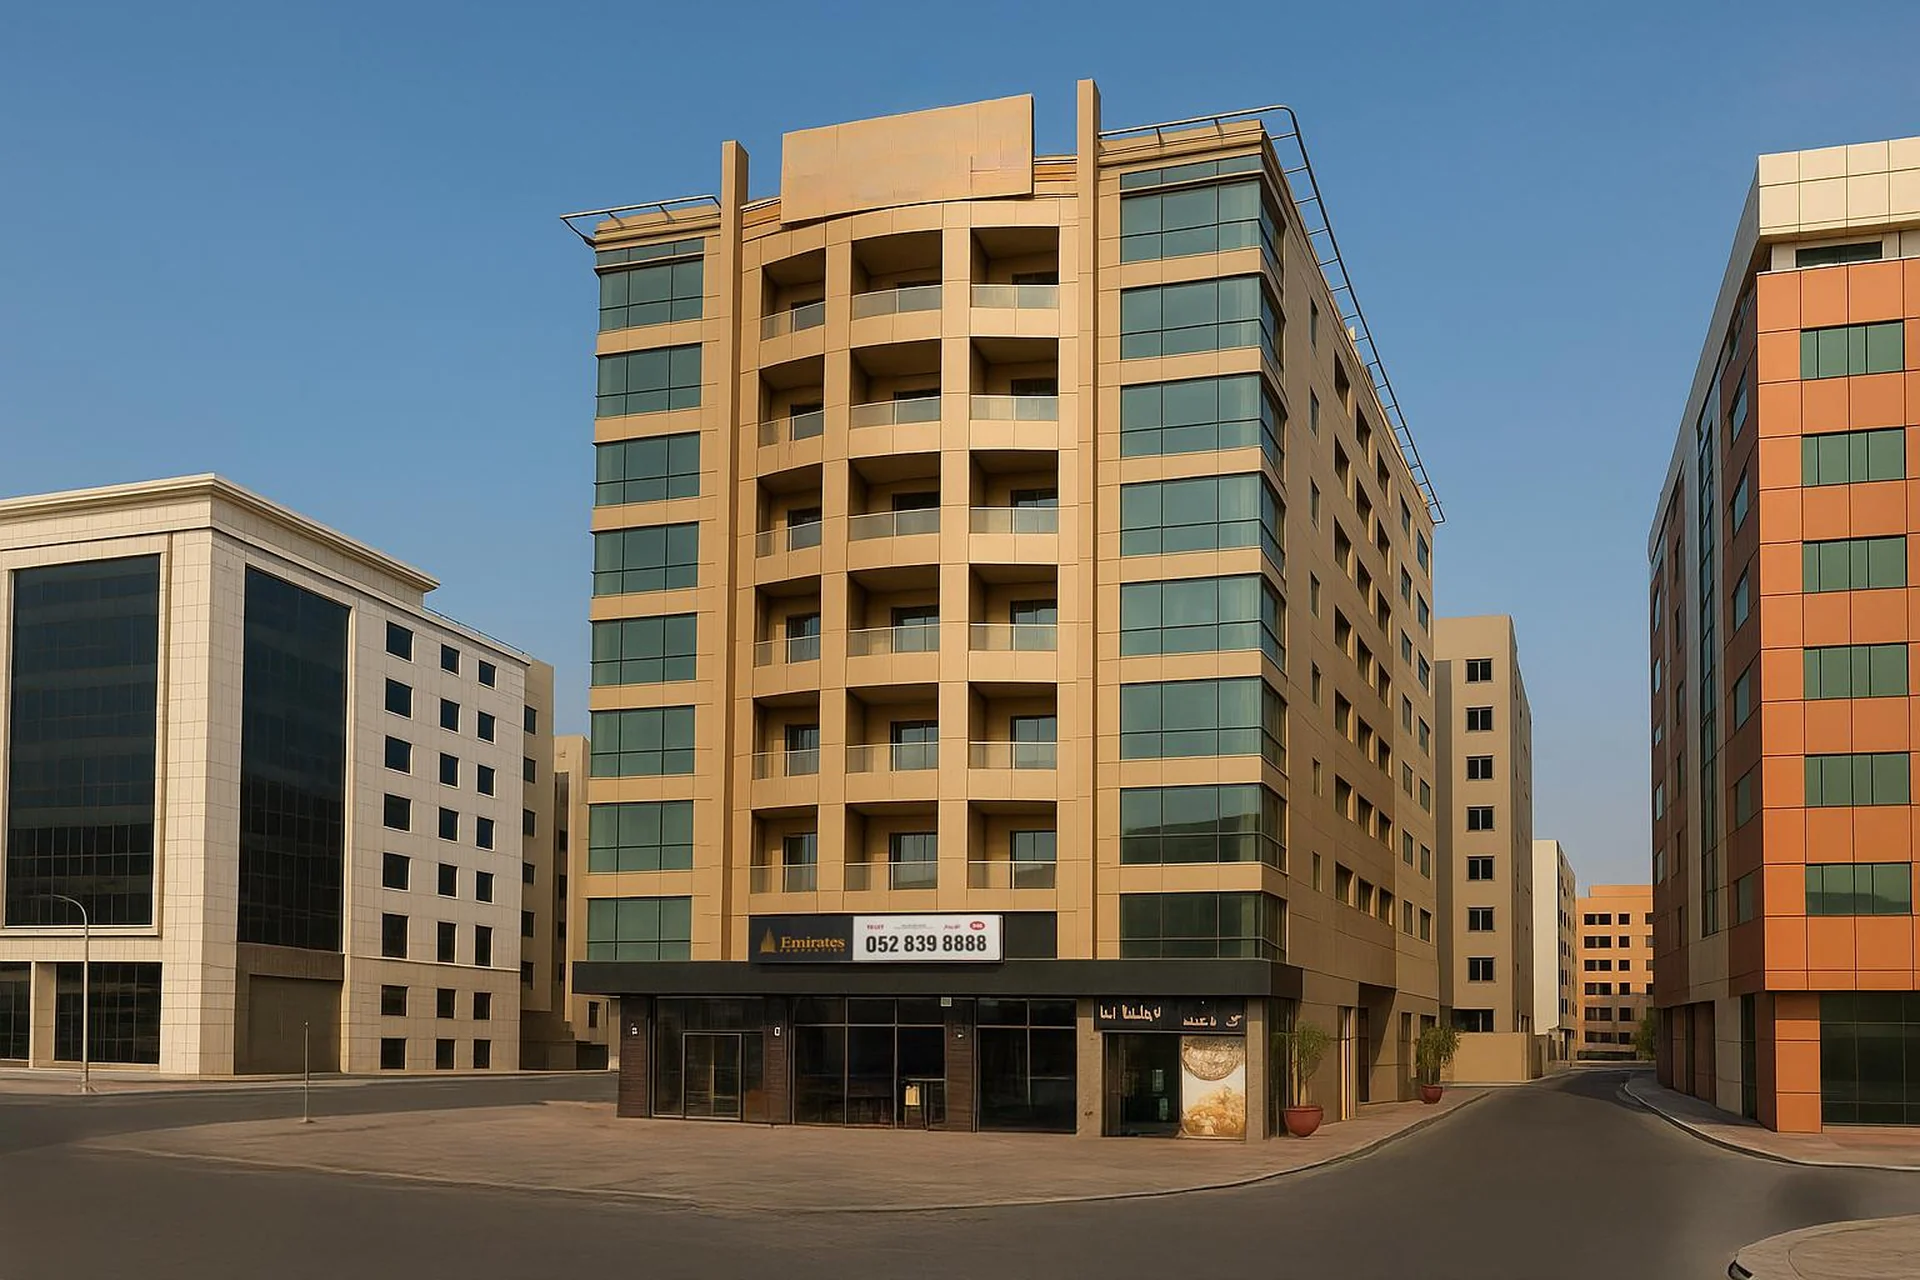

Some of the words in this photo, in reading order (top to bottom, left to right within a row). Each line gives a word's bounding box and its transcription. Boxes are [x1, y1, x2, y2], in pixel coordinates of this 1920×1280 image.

[781, 935, 846, 948] Emirates
[866, 935, 899, 953] 052
[904, 934, 937, 952] 839
[942, 934, 987, 952] 8888
